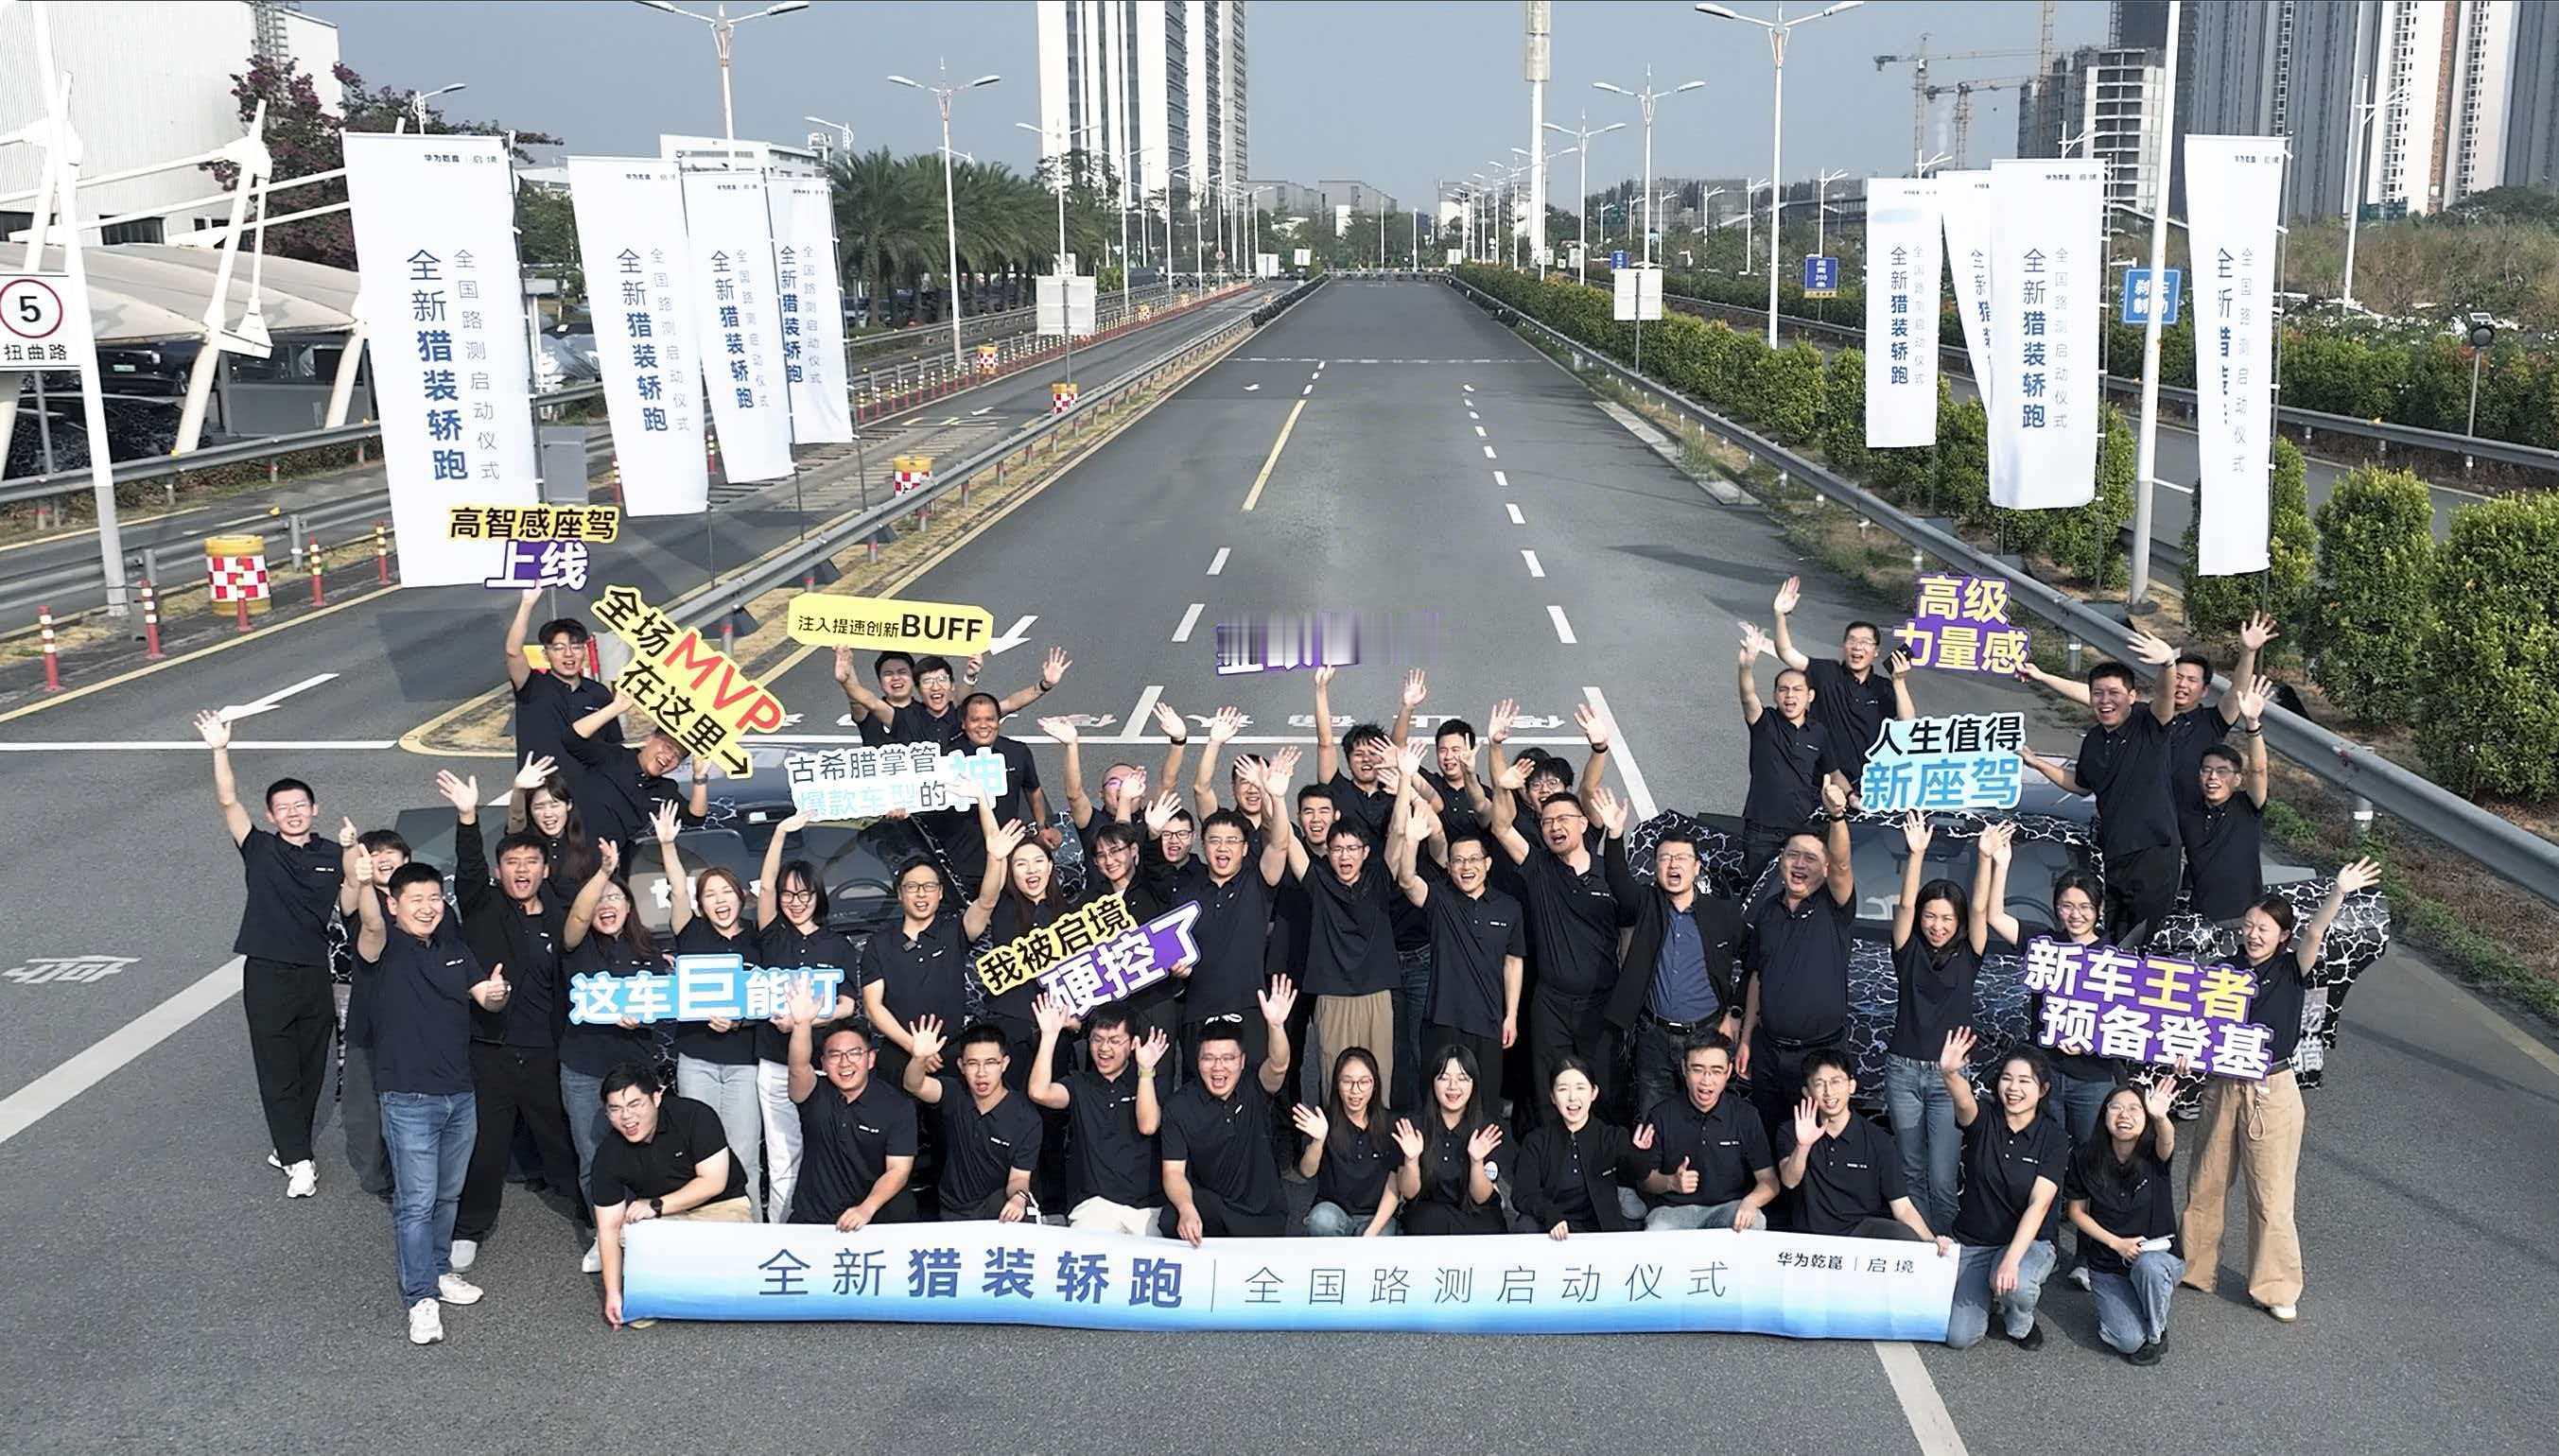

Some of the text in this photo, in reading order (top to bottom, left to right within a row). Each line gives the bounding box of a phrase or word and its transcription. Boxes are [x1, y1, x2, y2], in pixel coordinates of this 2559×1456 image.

[19, 295, 42, 322] 5
[617, 248, 668, 433] 全新猎装轿跑
[710, 249, 756, 409] 全新猎装轿跑
[1890, 247, 1908, 385] 全新猎装轿跑
[2022, 248, 2045, 429] 全新猎装轿跑
[4, 343, 67, 361] 扭曲路
[407, 249, 469, 482] 全新猎装轿跑
[453, 249, 500, 481] 全国路测启动仪式
[450, 507, 617, 540] 高智感座驾
[486, 541, 588, 589] 上线
[1918, 574, 2011, 625] 高级
[595, 586, 783, 733] 全场MVP
[1892, 620, 2029, 675] 力量感
[618, 659, 727, 756] 在这里
[1867, 715, 2023, 757] 人生值得
[790, 745, 936, 784] 古希腊掌管
[1859, 757, 2020, 810] 新座驾
[980, 898, 1132, 992] 我被启境
[1040, 903, 1202, 1017] 硬控了
[2024, 939, 2256, 1024] 新车王者
[2039, 995, 2272, 1081] 预备登基
[757, 1246, 1184, 1309] 全新猎装轿跑
[1243, 1257, 1731, 1308] 全国路测启动仪式
[1777, 1251, 1915, 1274] 华为乾崑 启境
